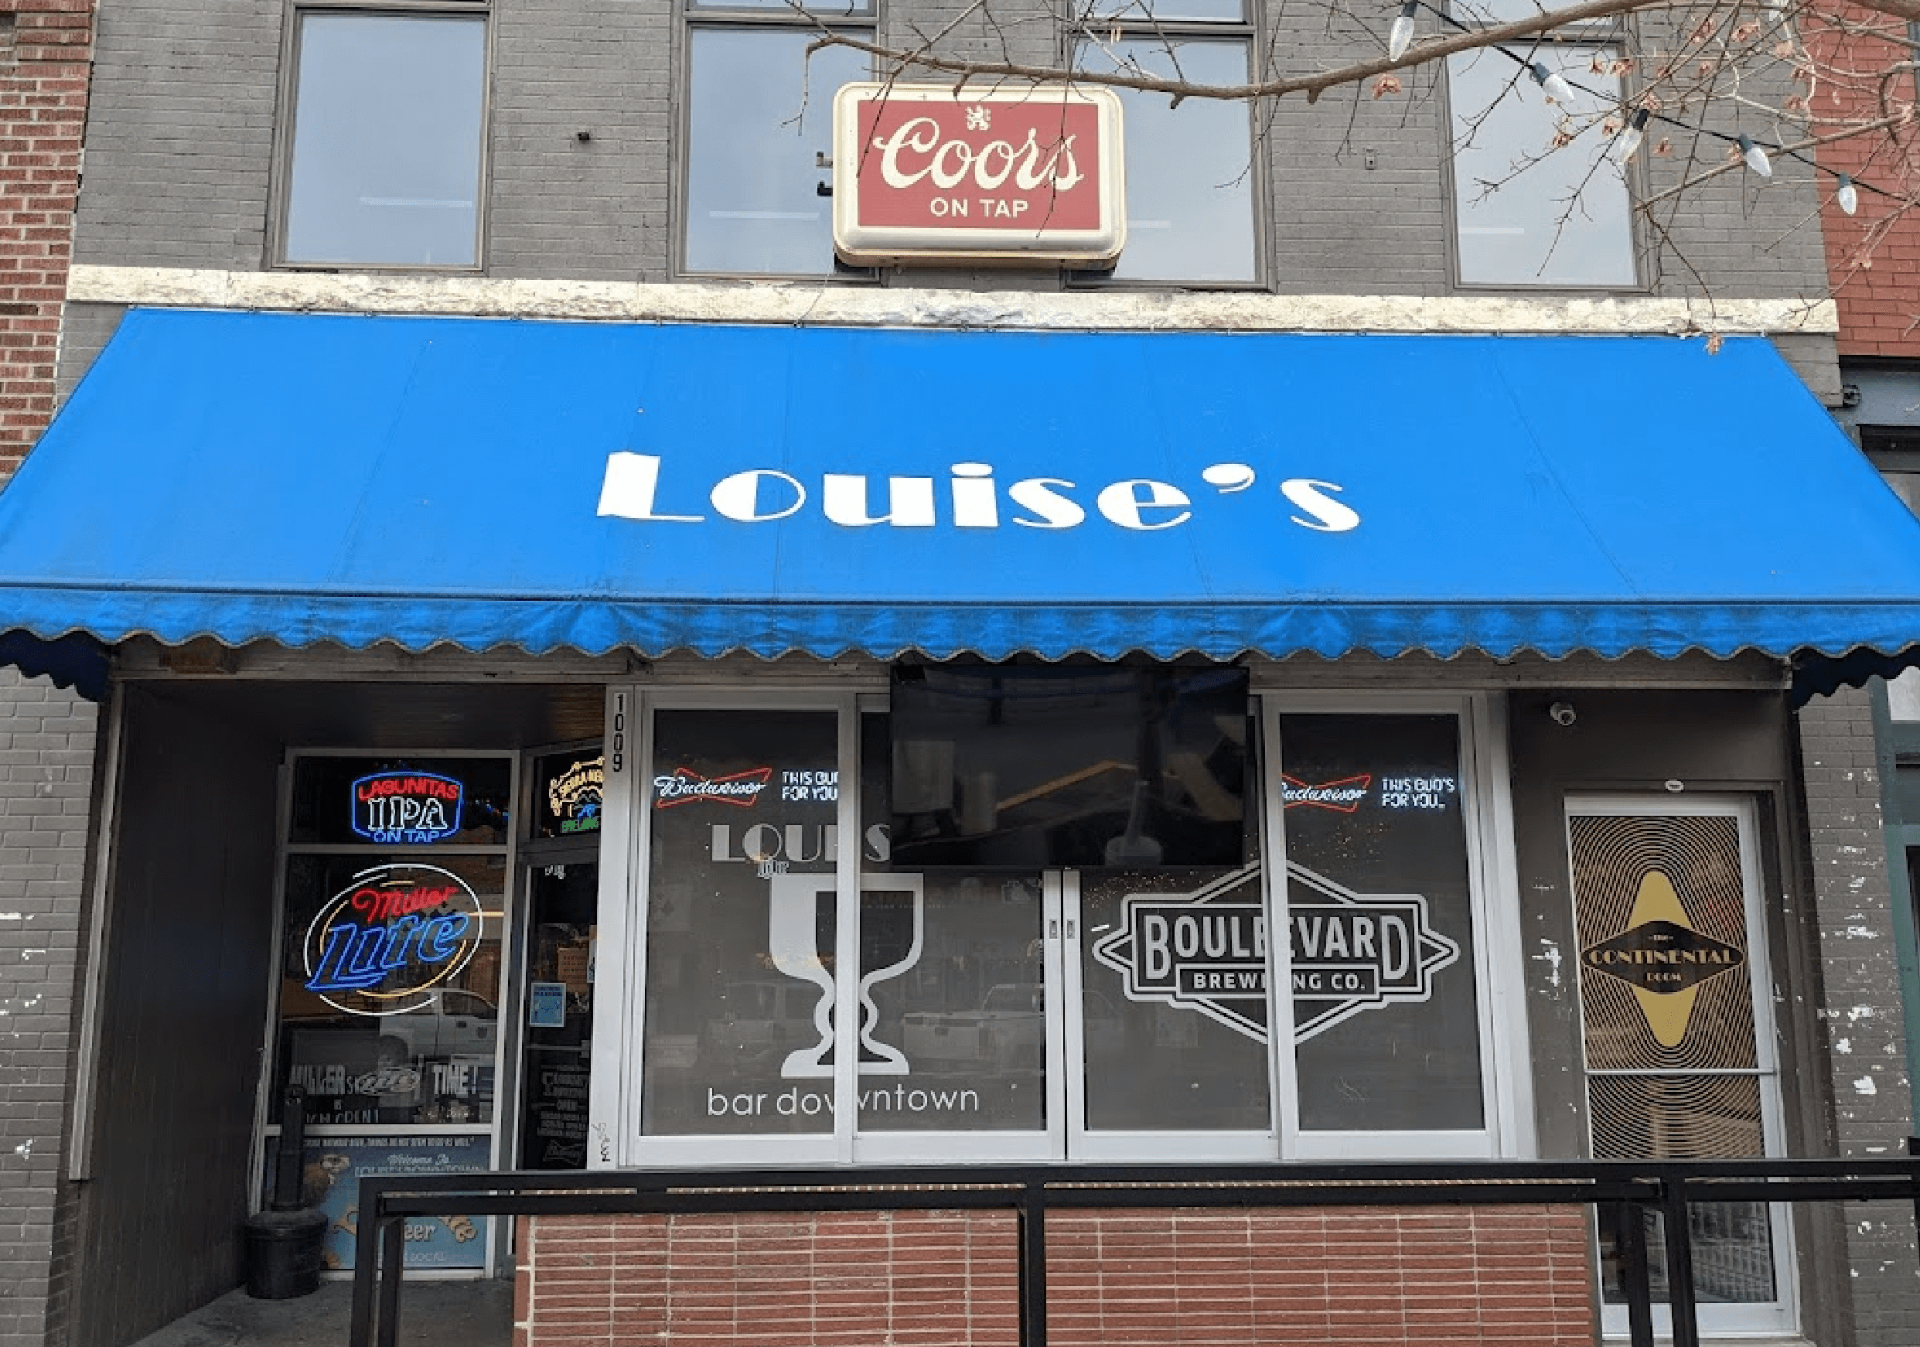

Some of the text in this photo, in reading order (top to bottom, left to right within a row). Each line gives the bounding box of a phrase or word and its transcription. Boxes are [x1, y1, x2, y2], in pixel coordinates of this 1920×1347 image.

[872, 116, 1084, 190] Coors
[930, 197, 1029, 218] ON TAP
[595, 450, 1362, 532] Louise's
[612, 692, 627, 772] 1009
[359, 776, 460, 801] LAGUNITAS
[653, 775, 767, 797] Budweiser
[781, 771, 813, 786] THIS
[1381, 777, 1456, 792] THIS BUD'S
[781, 786, 809, 801] FOR
[1281, 782, 1368, 801] udweiser
[1381, 793, 1410, 808] FOR
[367, 796, 448, 831] IPA
[372, 830, 440, 844] ON TAP
[351, 884, 460, 924] Miller
[304, 912, 470, 992] Lite
[1143, 914, 1411, 980] BOULEVARD
[1588, 949, 1736, 965] CONTINENTAL
[1193, 973, 1366, 991] BREWING CO.
[707, 1083, 980, 1116] bar downtown
[404, 1224, 437, 1241] eer
